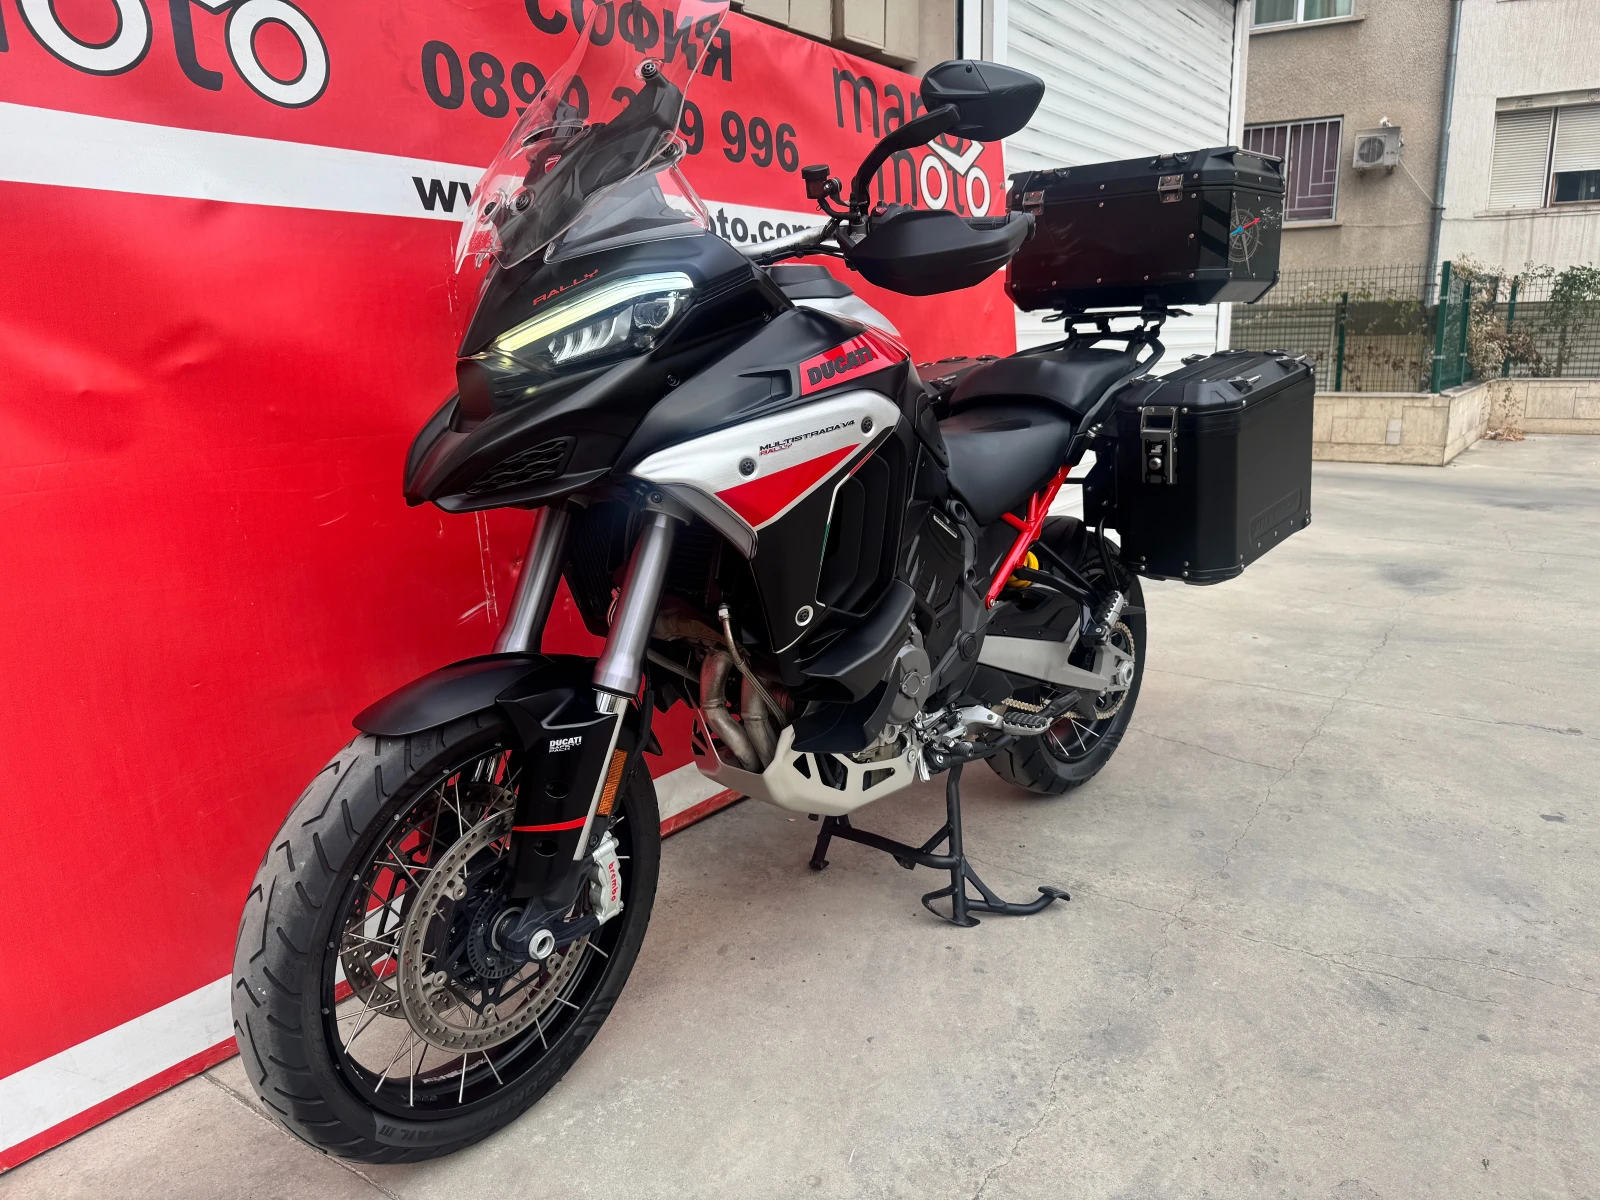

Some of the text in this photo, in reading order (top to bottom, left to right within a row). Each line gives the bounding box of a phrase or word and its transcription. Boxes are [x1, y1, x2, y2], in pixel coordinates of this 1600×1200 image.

[0, 0, 330, 109] oto
[721, 110, 799, 173] 996
[533, 269, 599, 306] RALLY
[806, 346, 874, 386] DUCATI
[759, 424, 841, 451] MULTISTRADA
[549, 735, 582, 747] DUCATI
[608, 861, 617, 902] brembo
